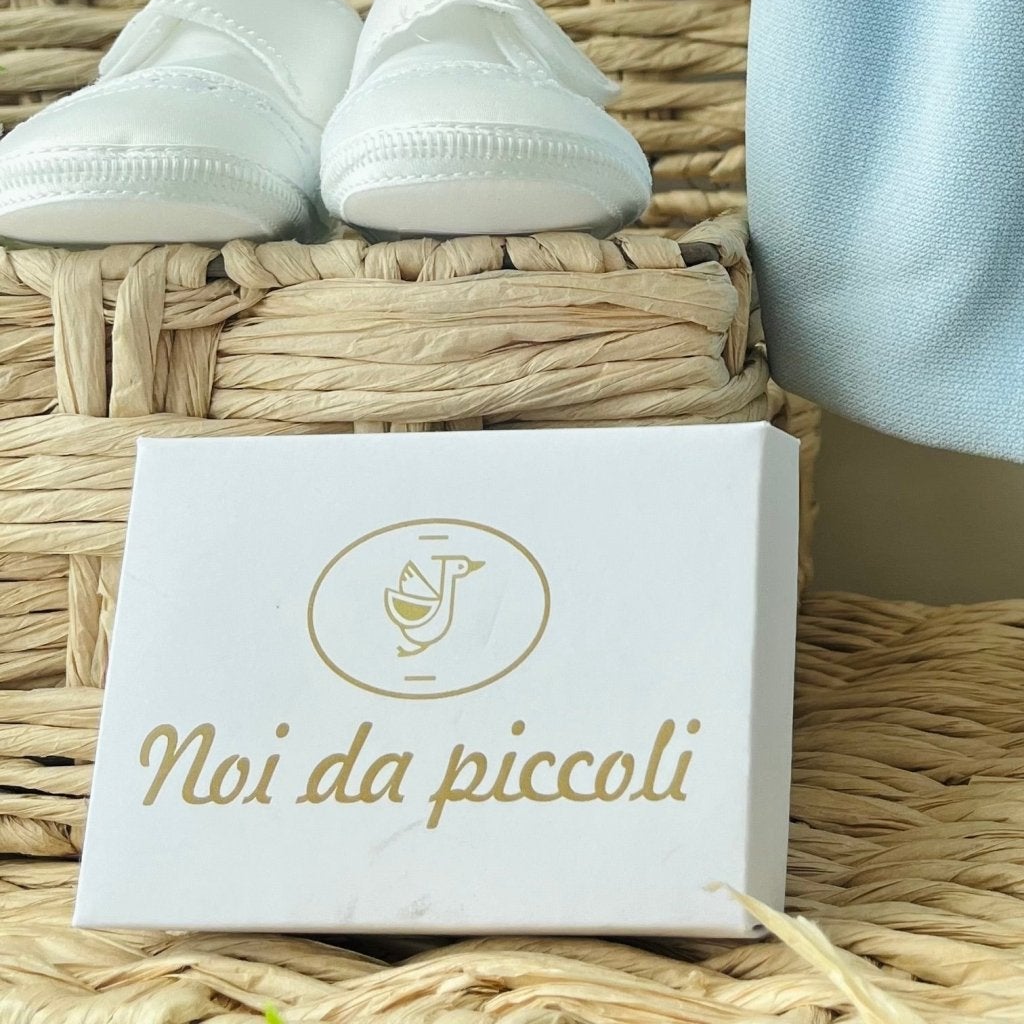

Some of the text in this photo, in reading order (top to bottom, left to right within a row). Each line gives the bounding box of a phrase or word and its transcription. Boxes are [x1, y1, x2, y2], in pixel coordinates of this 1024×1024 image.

[139, 719, 702, 830] Noi da piccoli
